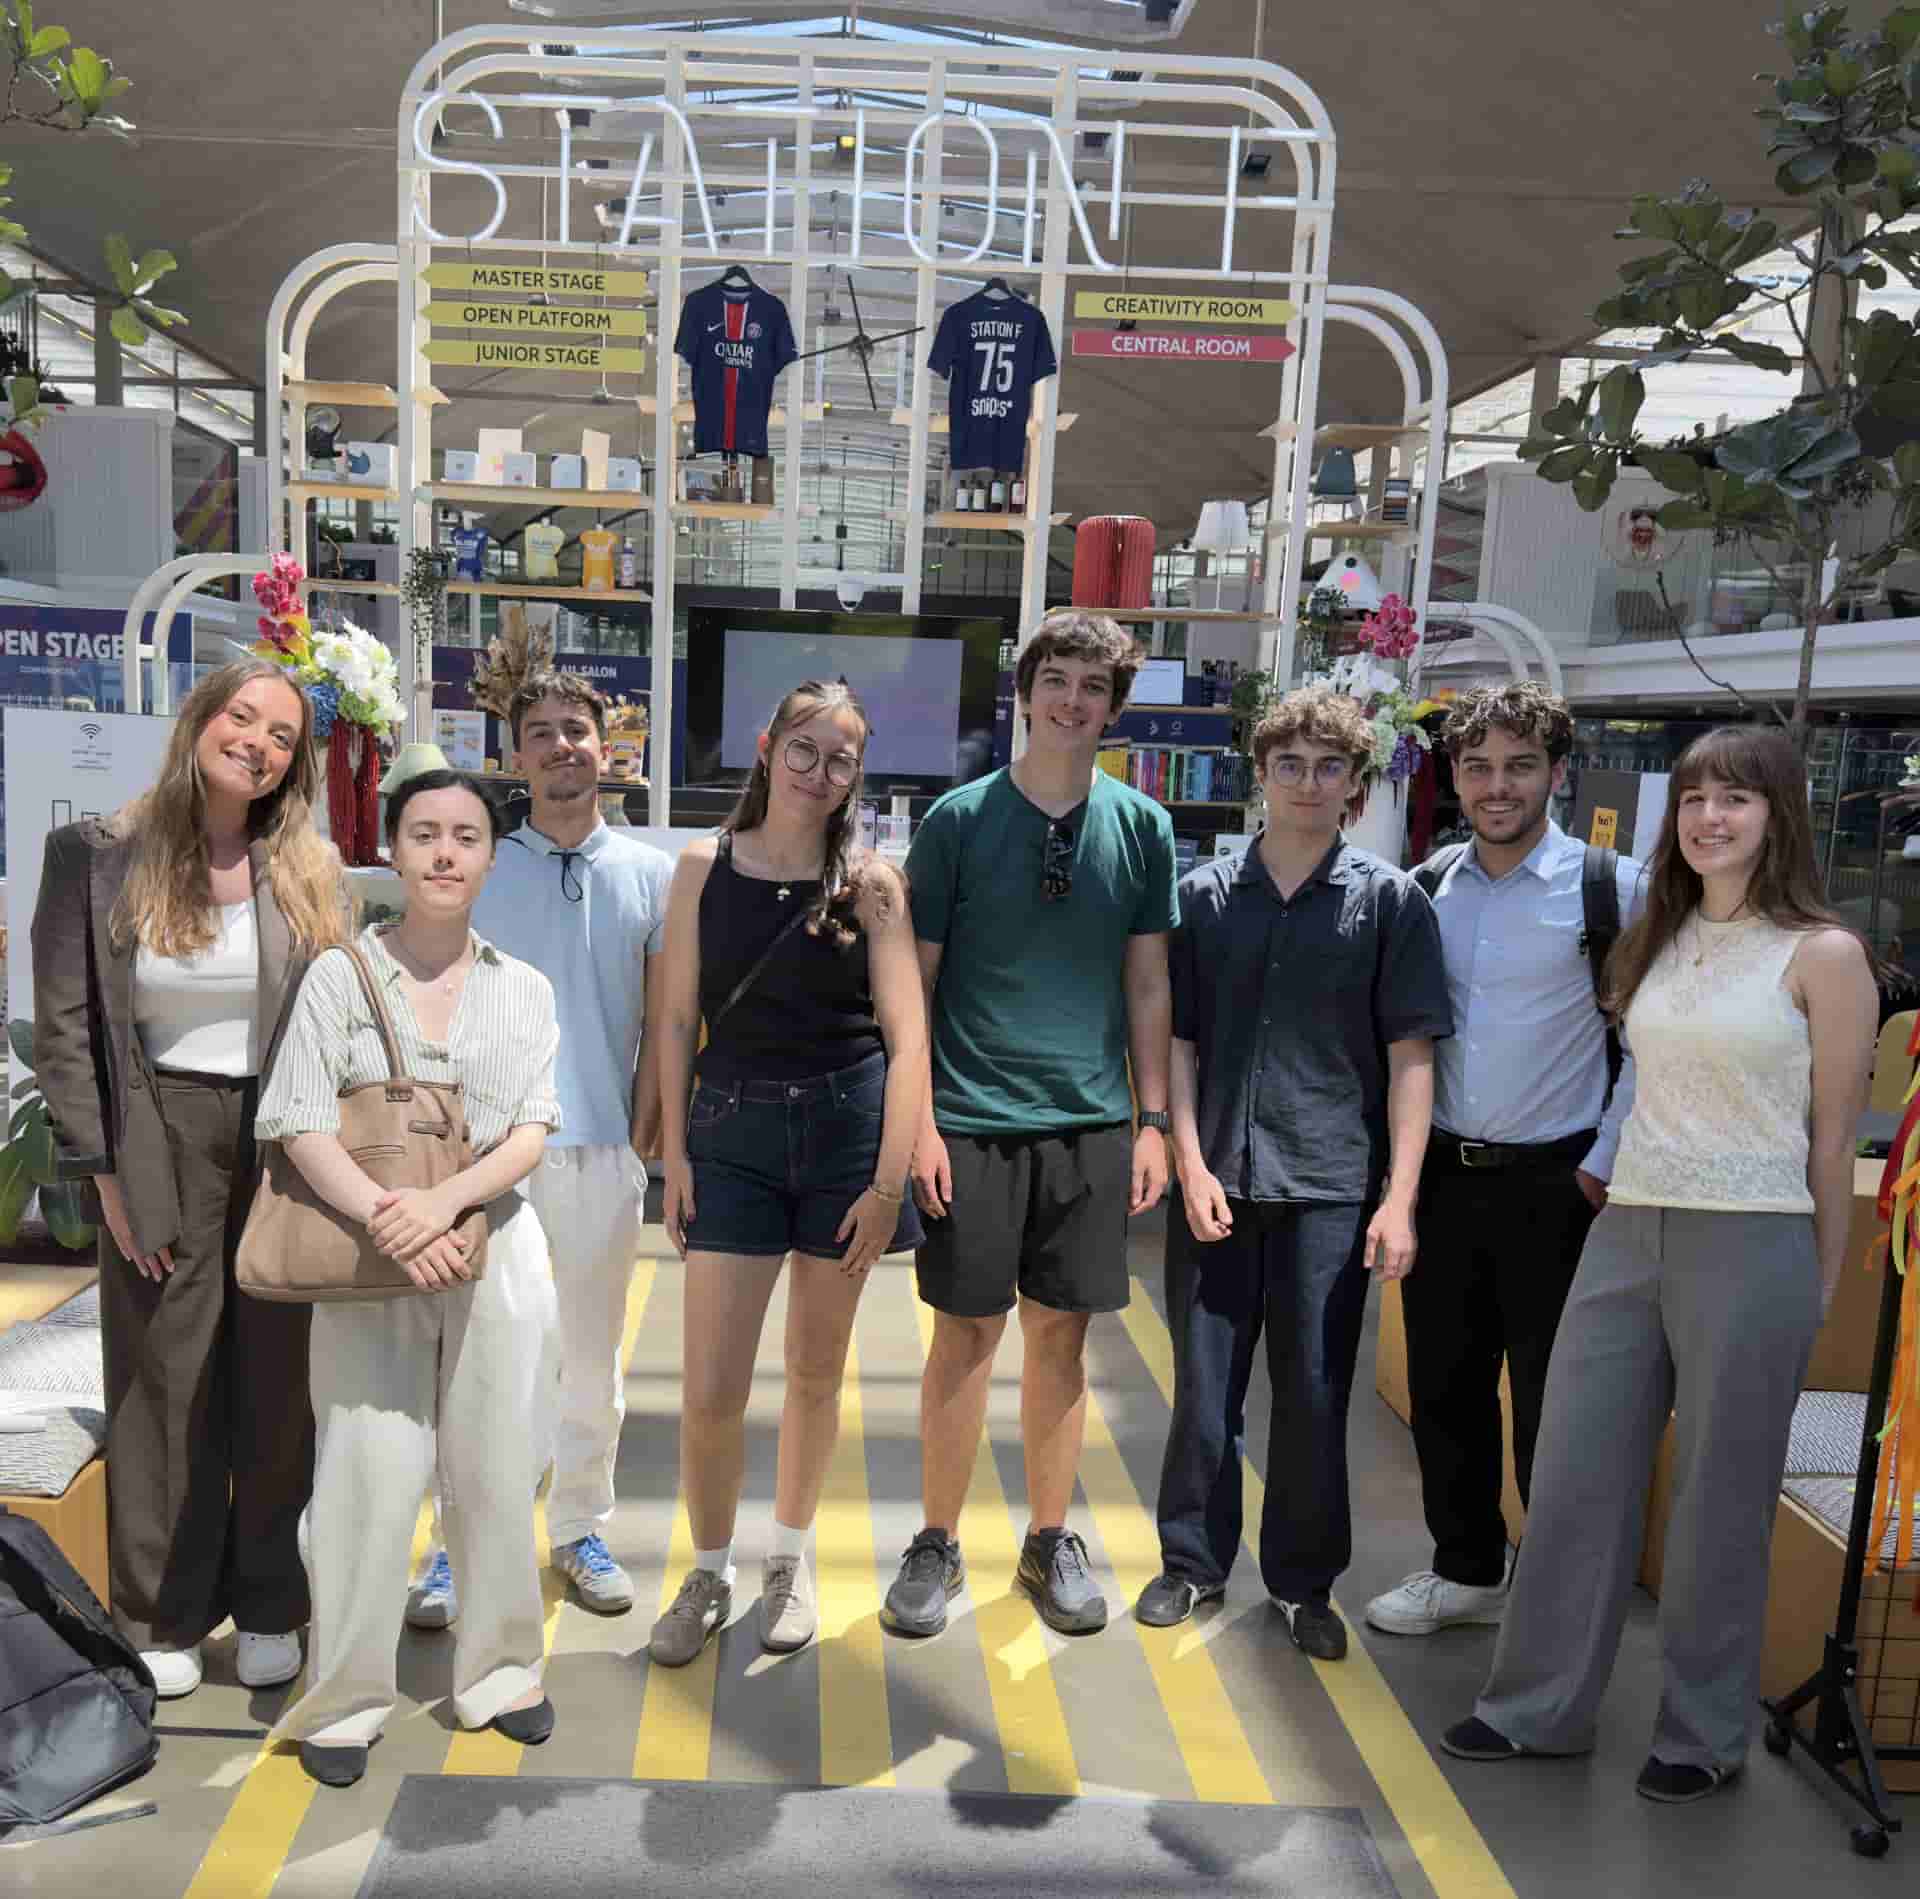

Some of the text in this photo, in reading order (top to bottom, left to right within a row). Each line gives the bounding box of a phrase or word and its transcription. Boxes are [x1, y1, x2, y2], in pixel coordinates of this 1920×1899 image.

[413, 90, 1125, 273] STATION
[472, 270, 605, 290] MASTER STAGE
[463, 307, 612, 329] OPEN PLATFORM
[1103, 297, 1264, 318] CREATIVITY ROOM
[970, 321, 1025, 339] STATION F
[475, 344, 601, 366] JUNIOR STAGE
[714, 342, 754, 360] QATAR
[1111, 336, 1251, 356] CENTRAL ROOM
[974, 342, 1016, 392] 75
[0, 629, 125, 660] EN STAGE
[581, 665, 617, 678] SALON
